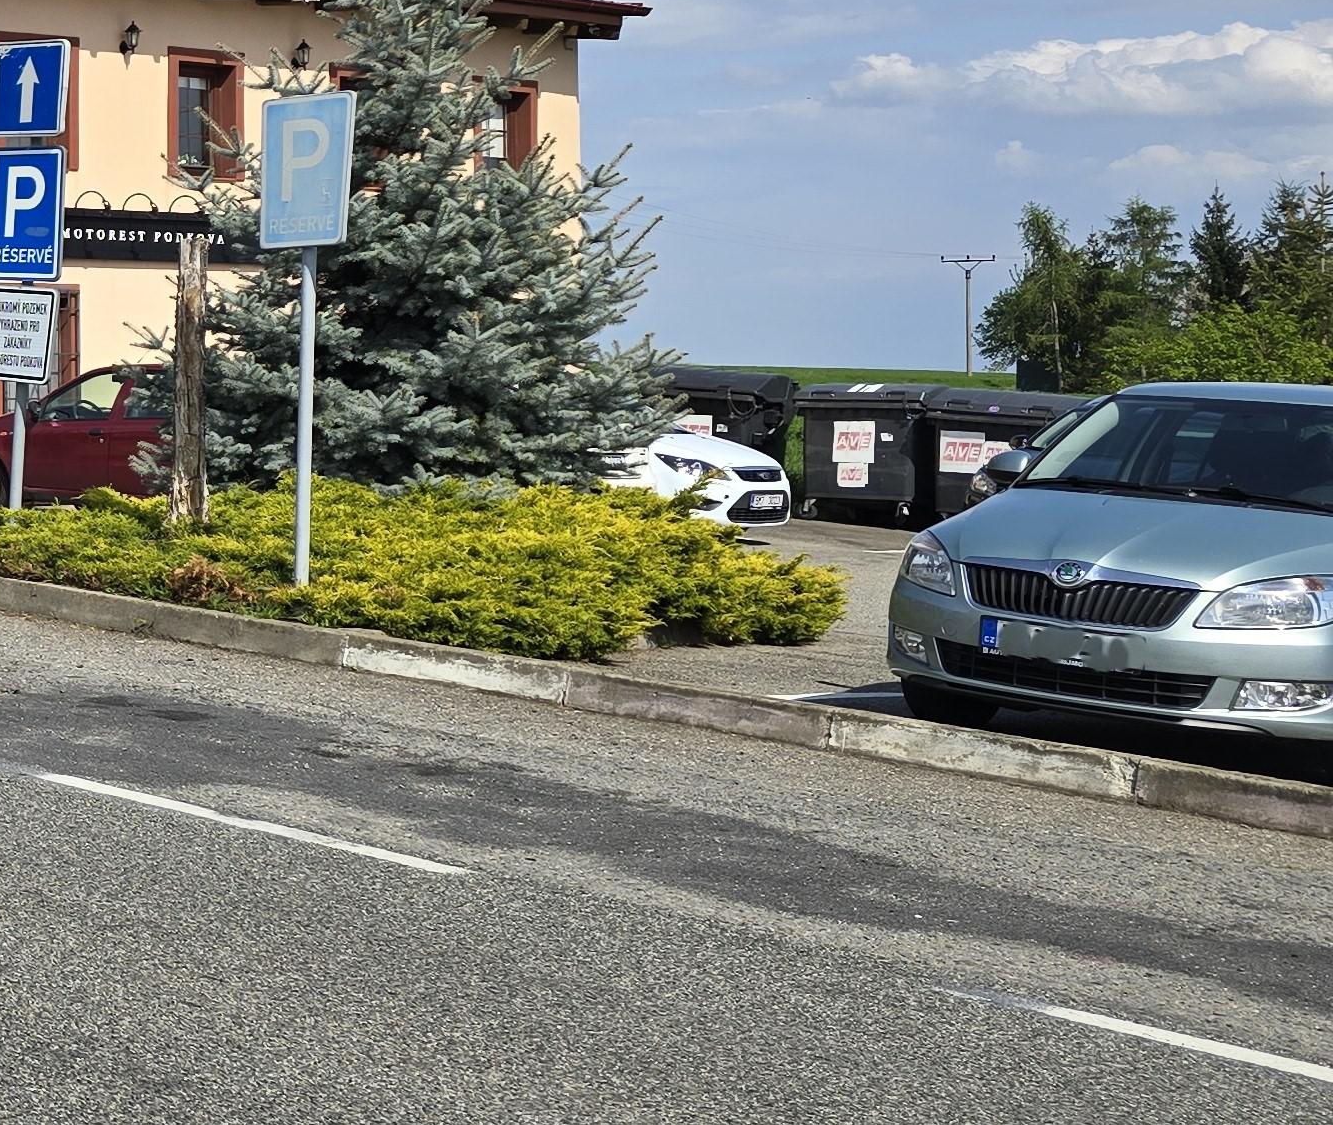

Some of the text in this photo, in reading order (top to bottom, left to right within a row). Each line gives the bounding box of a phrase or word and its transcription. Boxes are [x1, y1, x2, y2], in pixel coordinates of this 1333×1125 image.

[281, 118, 330, 204] P
[3, 165, 46, 238] P
[22, 302, 48, 315] POZEMEK
[29, 320, 40, 332] PRO
[837, 432, 871, 451] AVE
[943, 441, 982, 463] AVE
[984, 636, 996, 644] CZ
